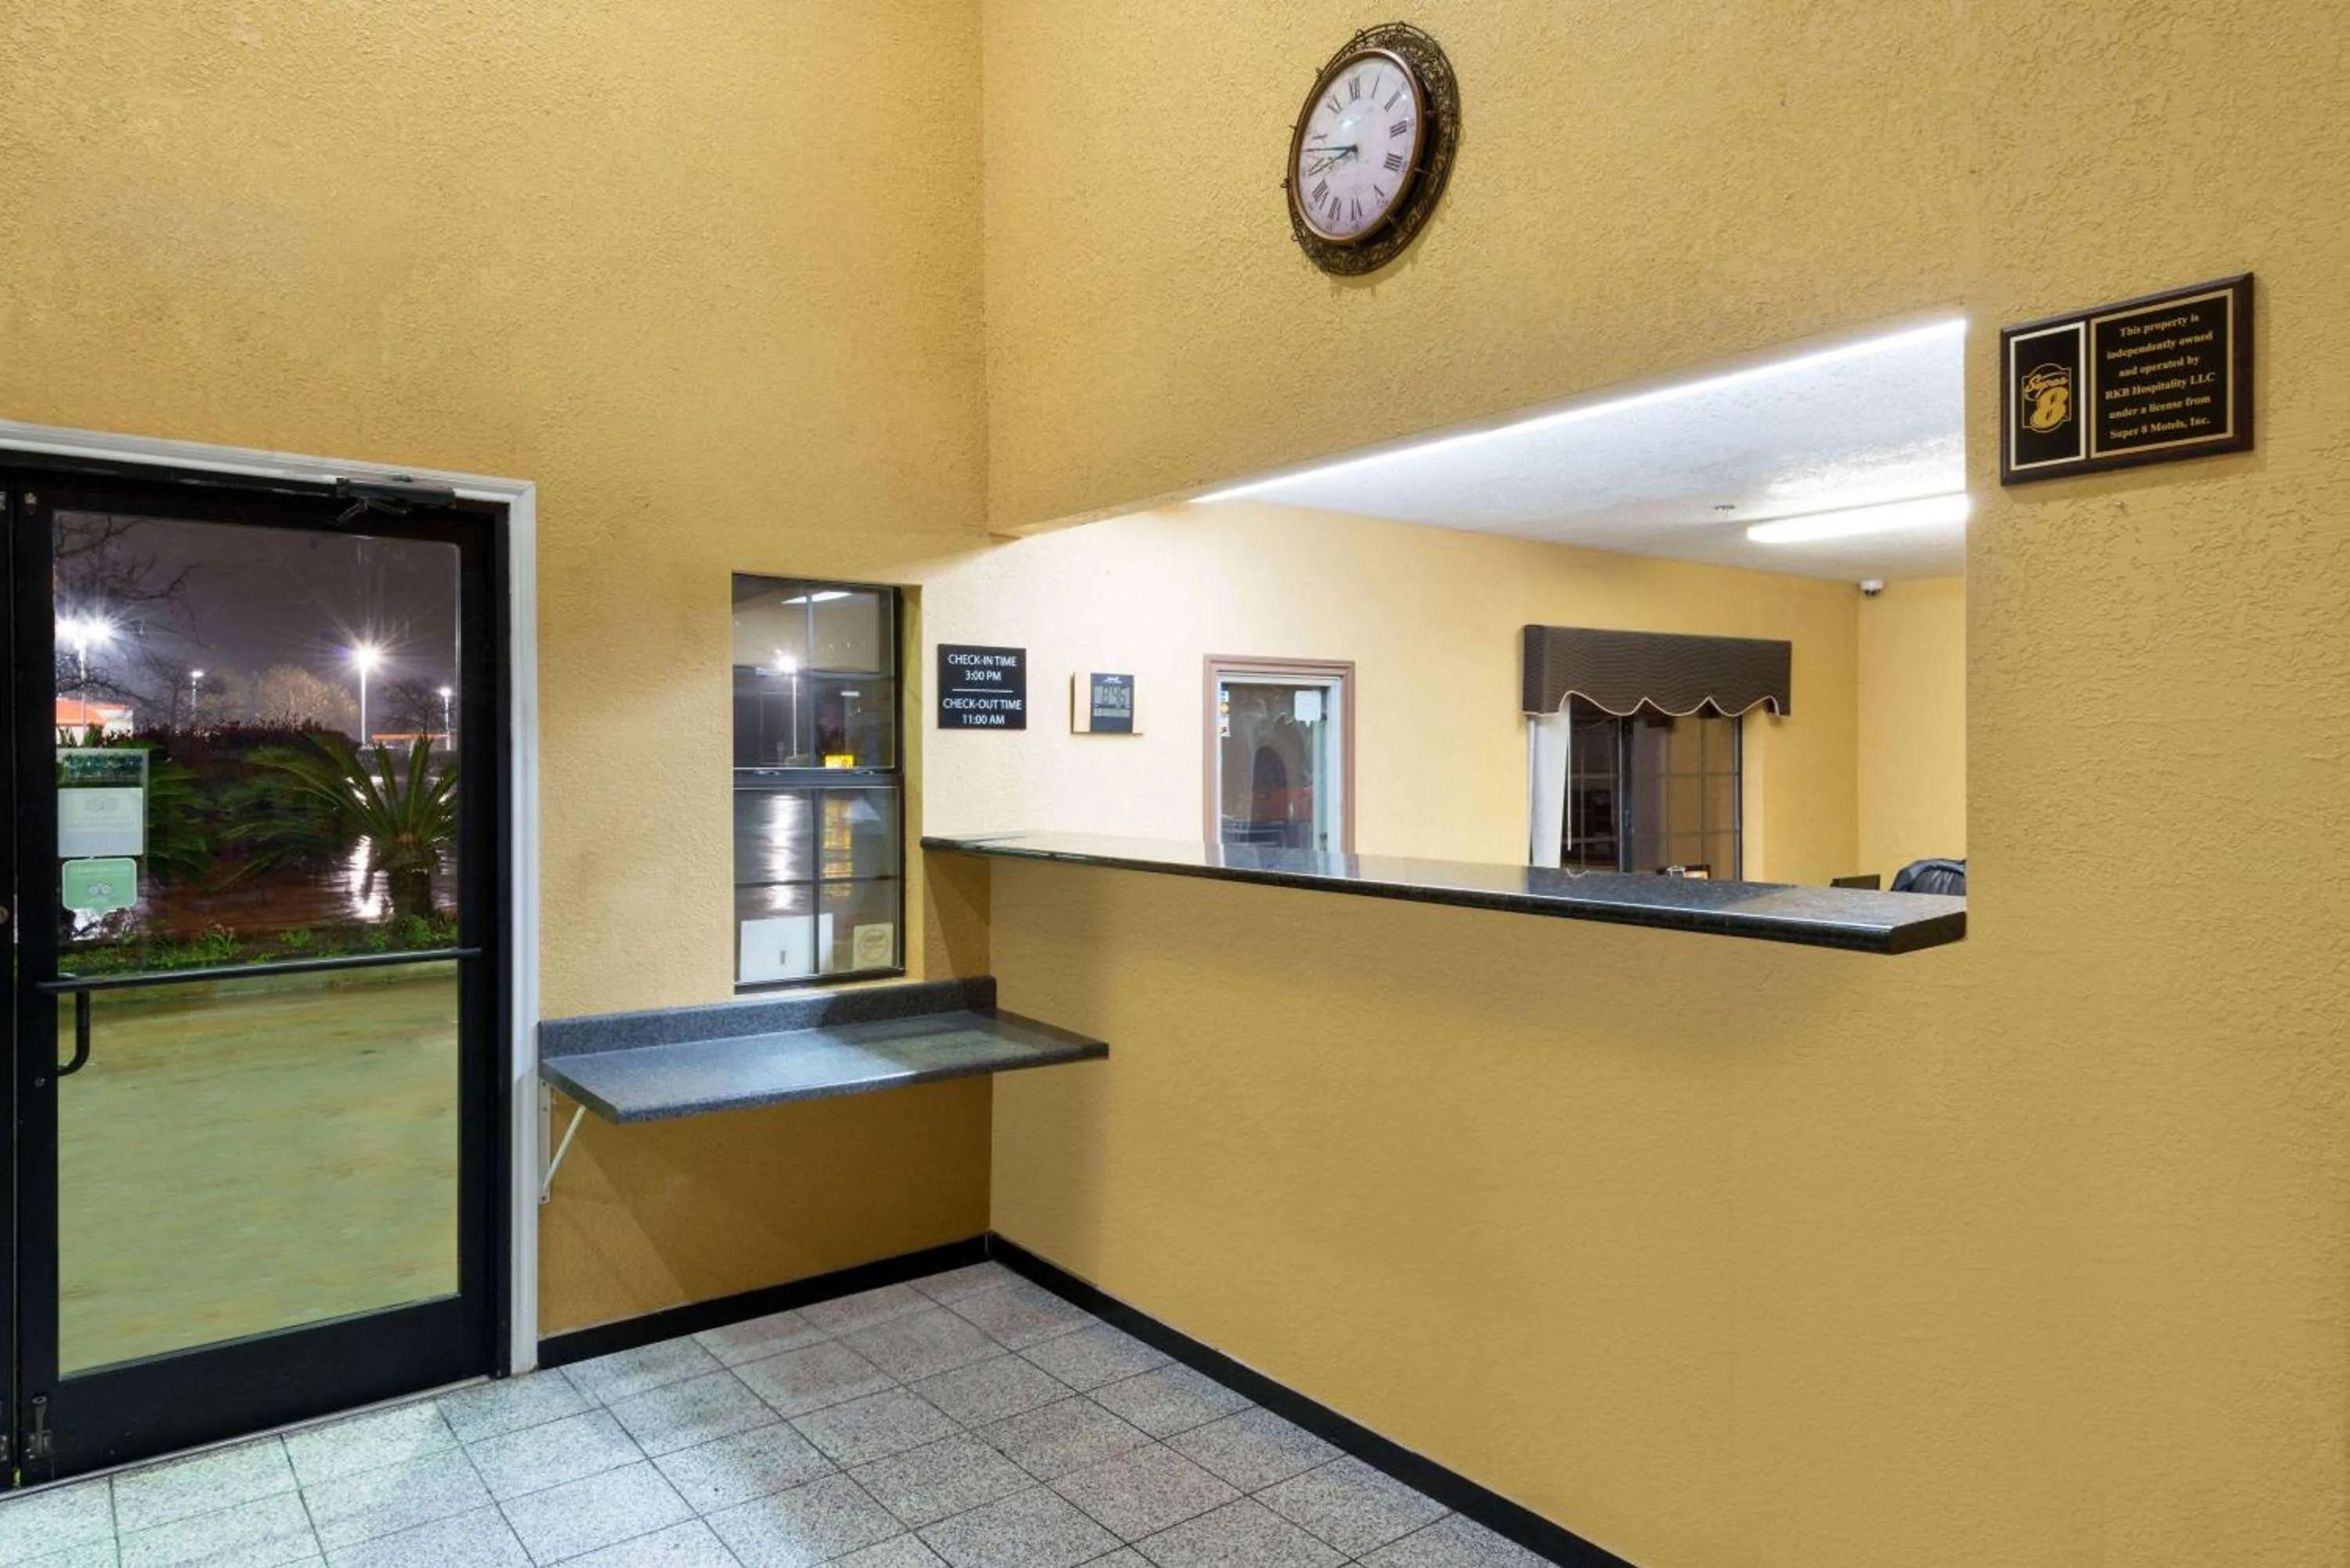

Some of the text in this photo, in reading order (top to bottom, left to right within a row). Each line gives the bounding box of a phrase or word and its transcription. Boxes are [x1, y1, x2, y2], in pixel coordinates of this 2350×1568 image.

[1389, 120, 1408, 138] III
[2120, 313, 2200, 338] This property is
[2106, 330, 2214, 360] independently owned
[2118, 354, 2200, 378] and operated by
[2131, 378, 2187, 396] Hospitality
[2189, 372, 2215, 385] LLC
[2030, 386, 2068, 428] 8
[2109, 406, 2139, 420] under
[2149, 400, 2183, 414] license
[2185, 396, 2211, 407] from
[2110, 417, 2211, 439] Super 8 Motels, Inc.
[948, 654, 1018, 667] CHECK-IN TIME
[965, 670, 1002, 681] 3:00 PM
[942, 698, 1022, 710] CHECK-OUT TIME
[963, 714, 1006, 725] 11:00 AM
